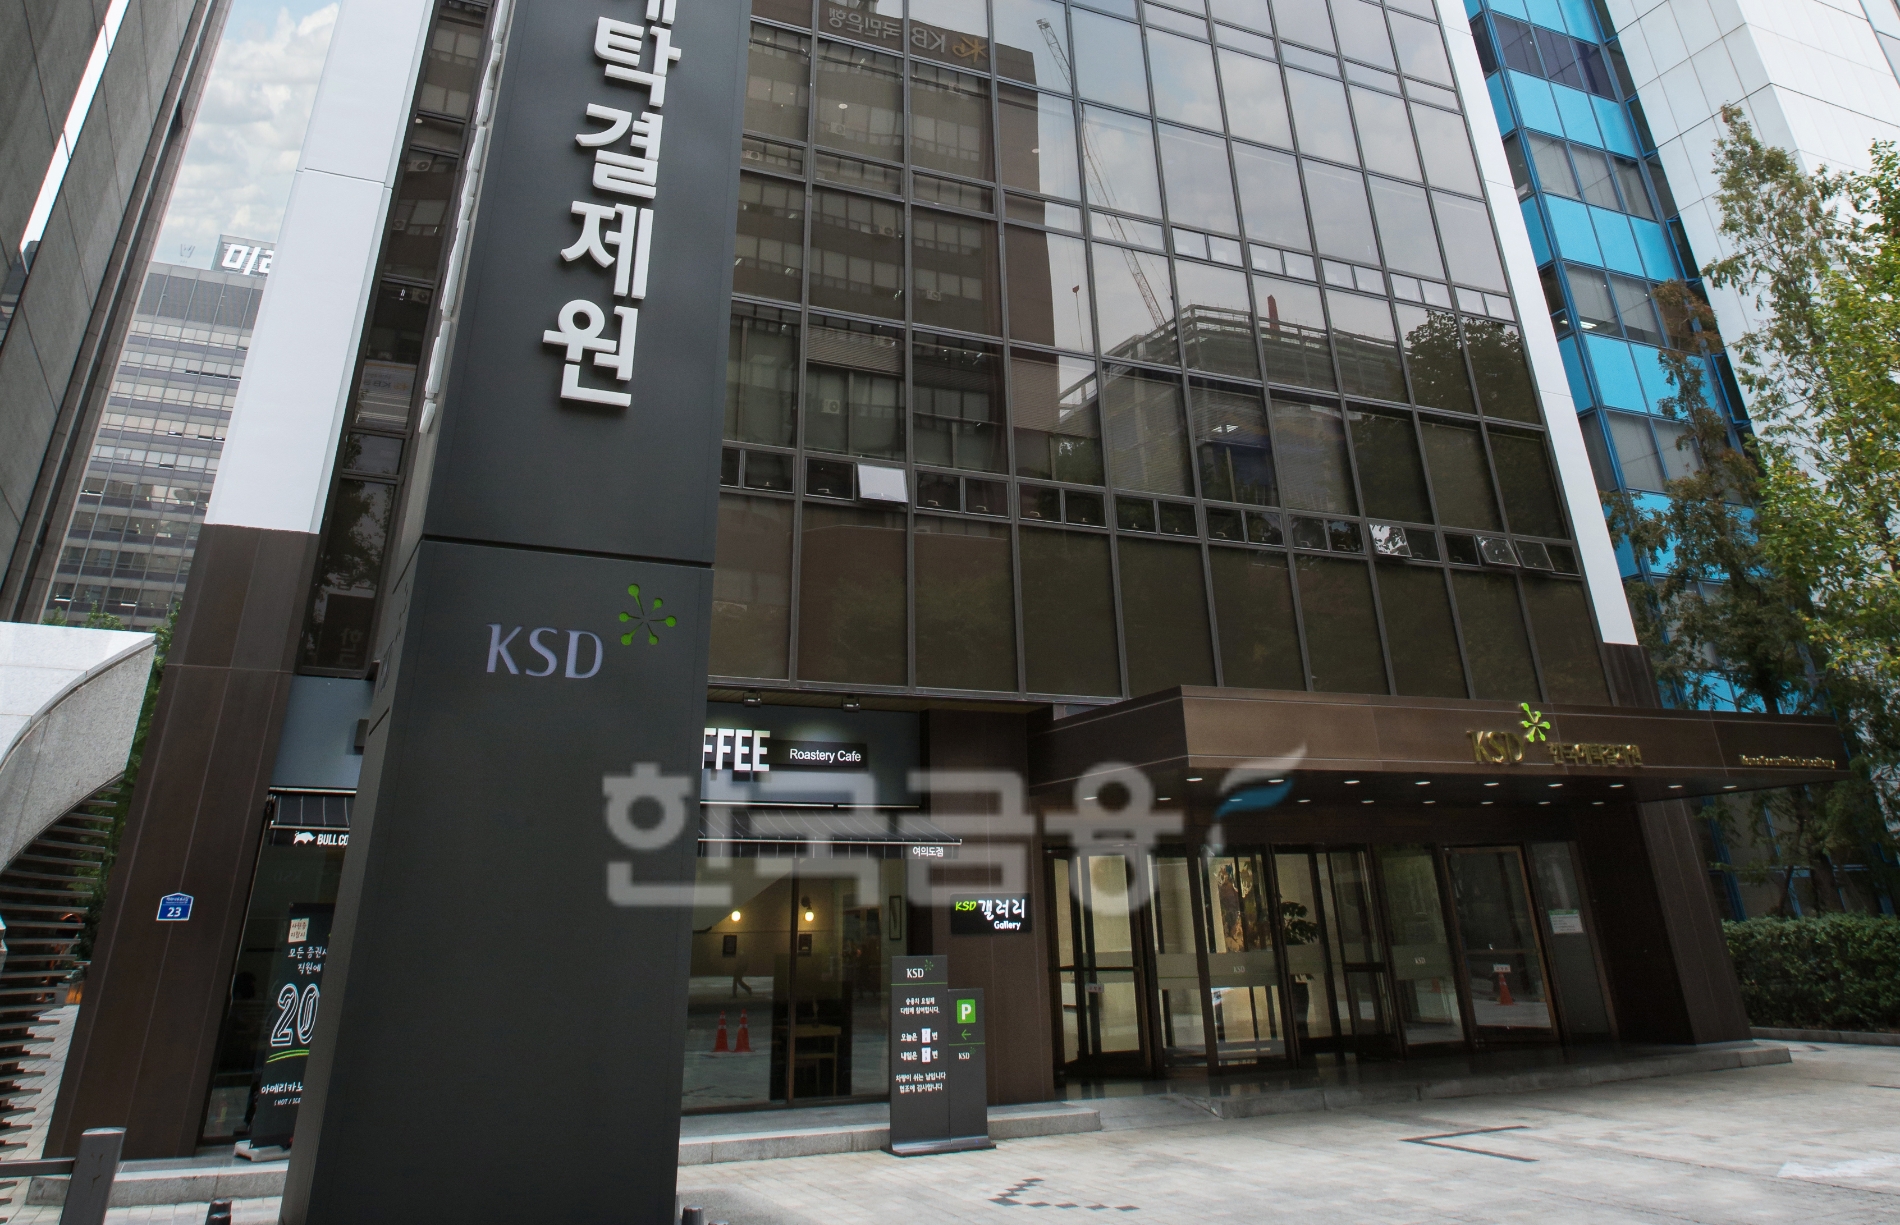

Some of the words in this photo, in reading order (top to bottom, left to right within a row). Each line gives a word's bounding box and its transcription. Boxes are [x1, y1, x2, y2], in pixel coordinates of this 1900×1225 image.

[486, 623, 604, 680] KSD
[1467, 731, 1525, 763] KSD
[789, 748, 835, 764] Roastery
[837, 750, 862, 763] Cafe
[317, 833, 338, 845] BULL
[912, 846, 944, 858] 여의도점
[166, 906, 182, 918] 23
[955, 901, 977, 911] KSD
[978, 898, 1025, 921] 갤러리
[993, 921, 1021, 931] Gallery
[288, 947, 304, 959] 모든
[906, 968, 924, 979] KSD
[271, 983, 320, 1046] 20
[961, 1004, 972, 1020] P
[958, 1052, 970, 1060] KSD
[261, 1082, 303, 1094] 아메리카노
